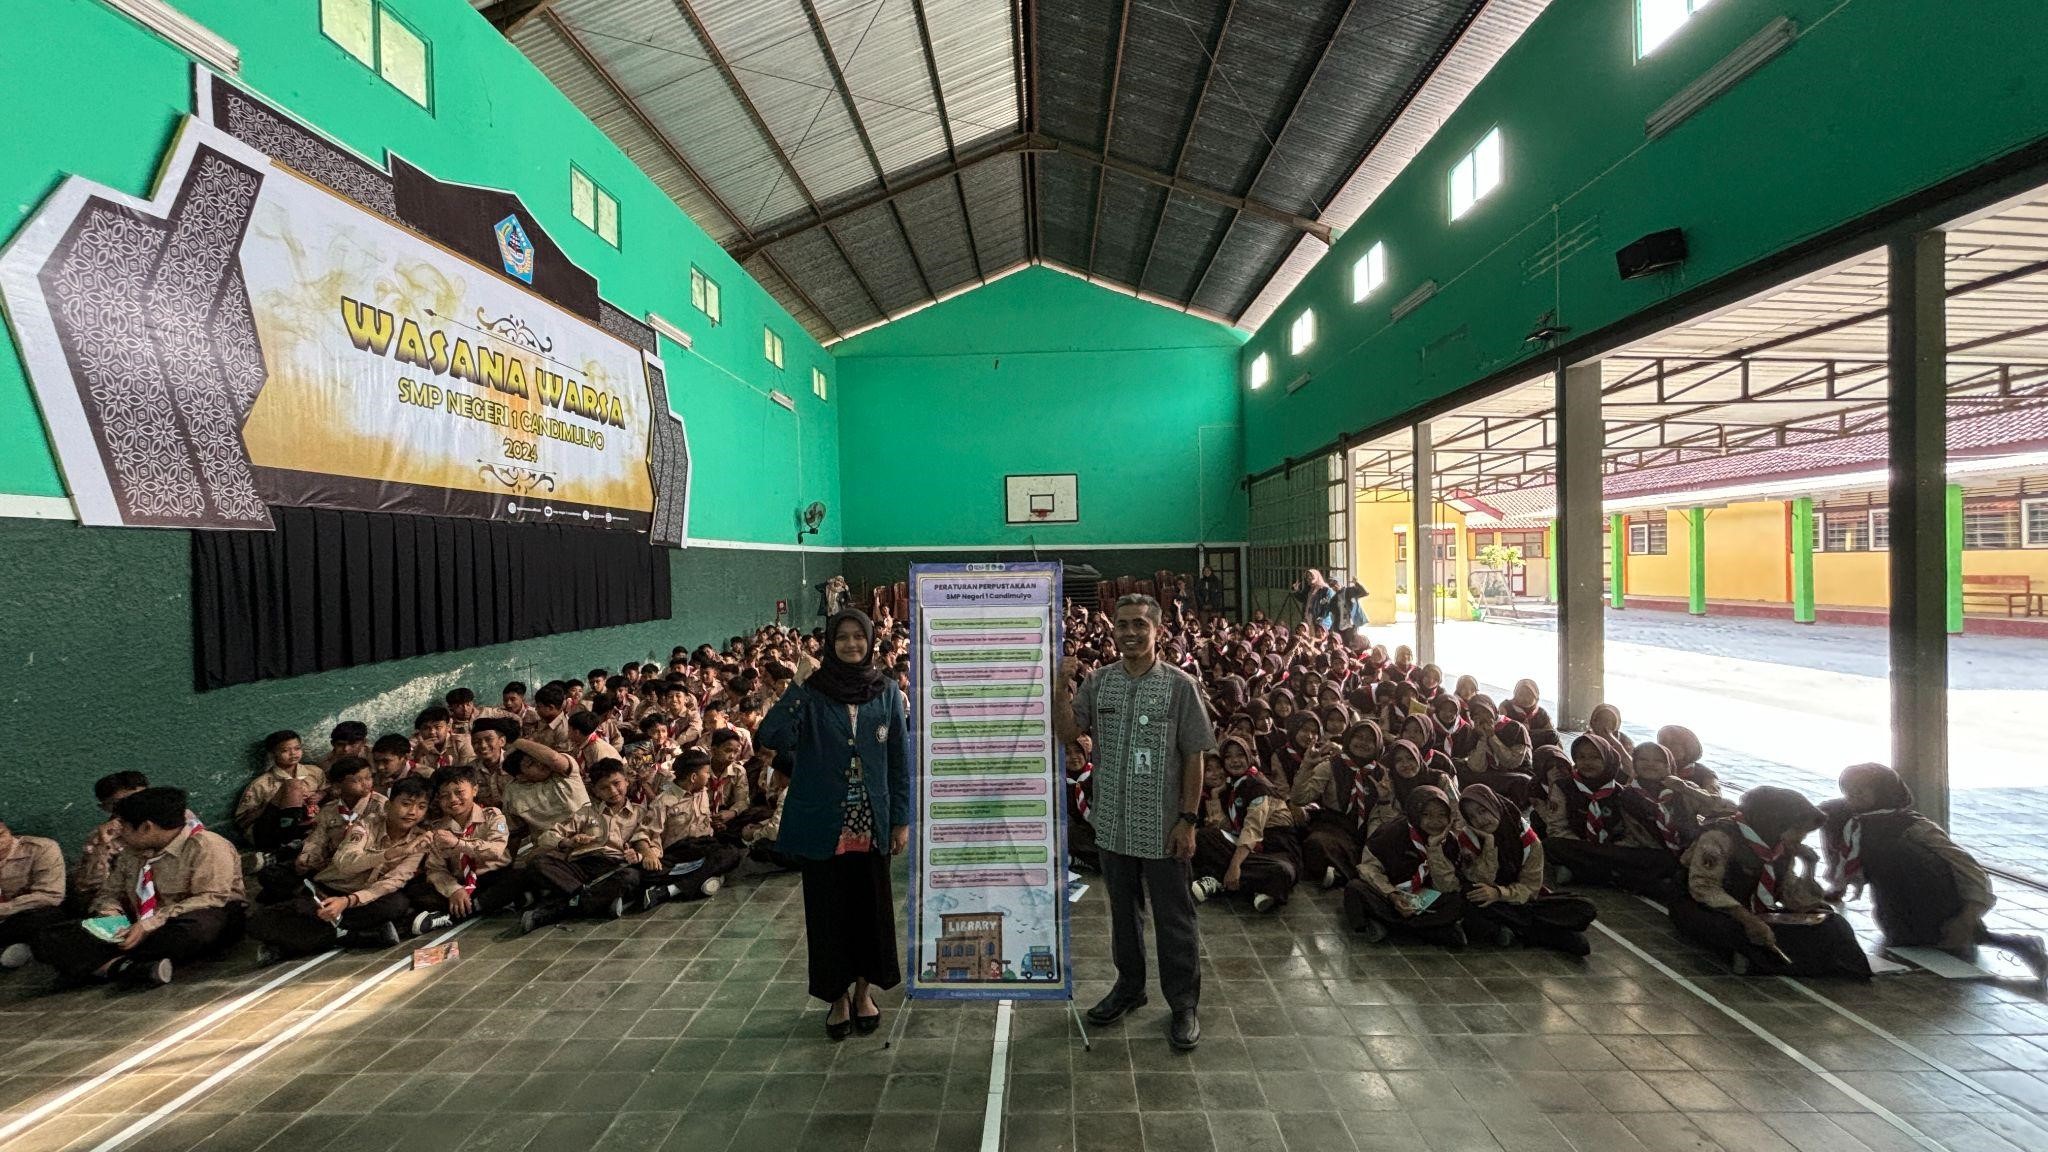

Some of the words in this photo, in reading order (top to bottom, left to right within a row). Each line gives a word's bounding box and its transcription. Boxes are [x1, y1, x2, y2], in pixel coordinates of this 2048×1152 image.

[341, 296, 529, 400] WASANA
[535, 367, 626, 430] WARSA
[398, 377, 443, 406] SMP
[447, 390, 509, 427] NEGERI
[512, 412, 518, 429] 1
[520, 411, 605, 451] CANDIMULYO
[504, 438, 538, 463] 2024
[934, 583, 977, 591] PERATURAN
[961, 593, 985, 601] Negeri
[989, 593, 1032, 601] Candimulyo
[948, 920, 997, 932] LIBRARY
